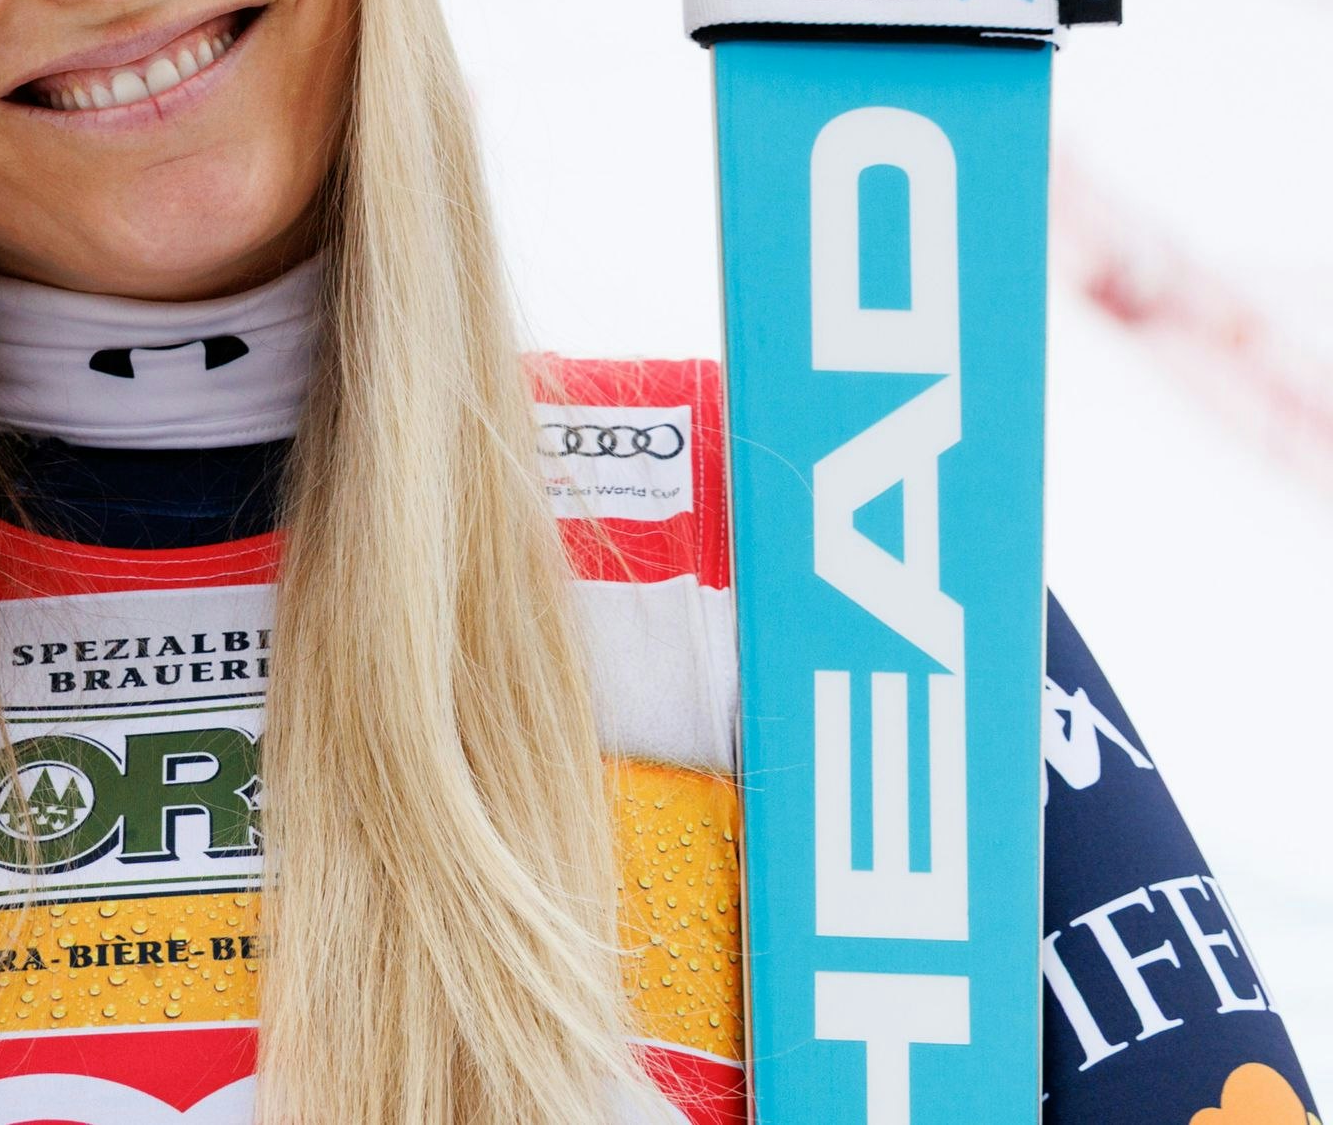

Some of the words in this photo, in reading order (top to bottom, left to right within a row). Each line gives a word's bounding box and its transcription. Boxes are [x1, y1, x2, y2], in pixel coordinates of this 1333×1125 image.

[596, 485, 648, 498] World
[12, 629, 272, 666] SPEZIALBI
[1042, 874, 1279, 1073] IFE
